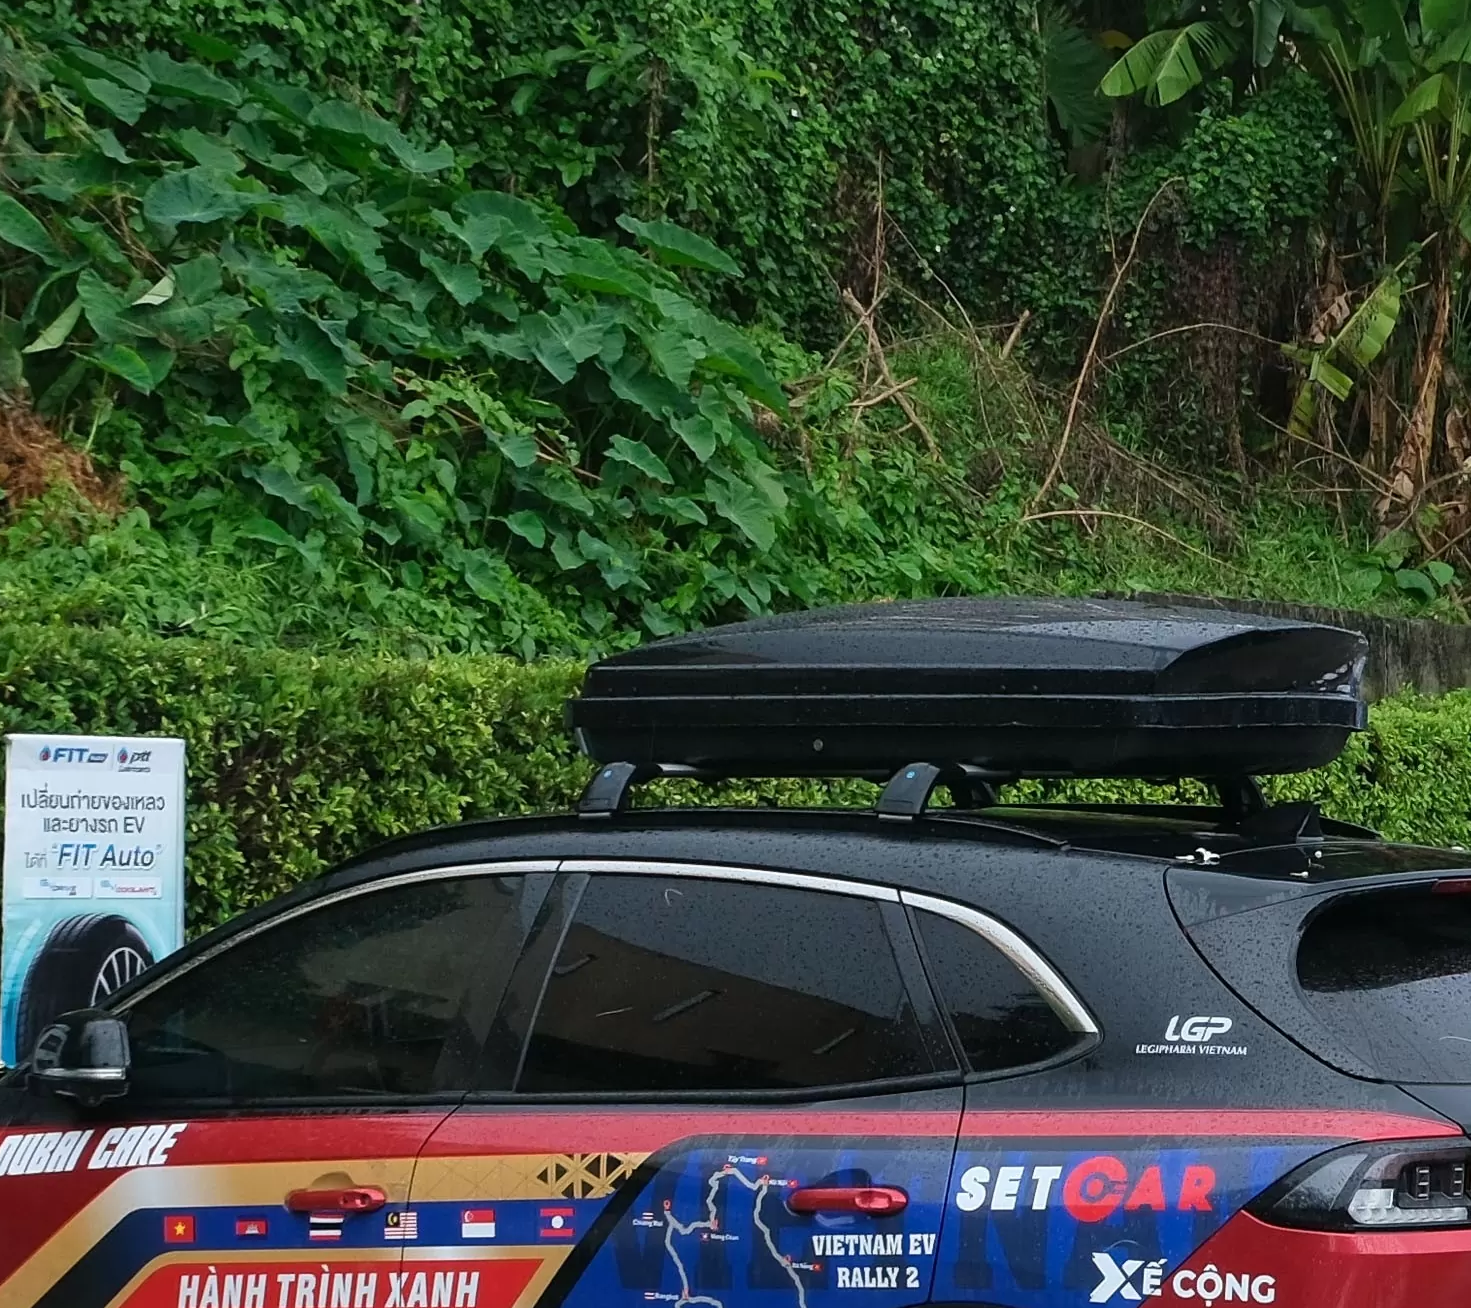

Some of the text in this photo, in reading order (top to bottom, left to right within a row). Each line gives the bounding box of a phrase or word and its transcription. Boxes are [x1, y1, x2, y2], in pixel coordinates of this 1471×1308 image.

[53, 748, 89, 763] FIT
[21, 783, 165, 810] เปลี่ยนถ่ายของเหลว
[124, 816, 146, 833] EV
[1165, 1015, 1232, 1042] LGP
[1135, 1043, 1248, 1056] LEGIPHARM VIETNAM
[87, 1123, 188, 1170] CARE
[812, 1233, 936, 1256] VIETNAM EV
[384, 1271, 480, 1308] XANH
[837, 1266, 920, 1289] RALLY 2
[1172, 1264, 1276, 1308] CỘNG
